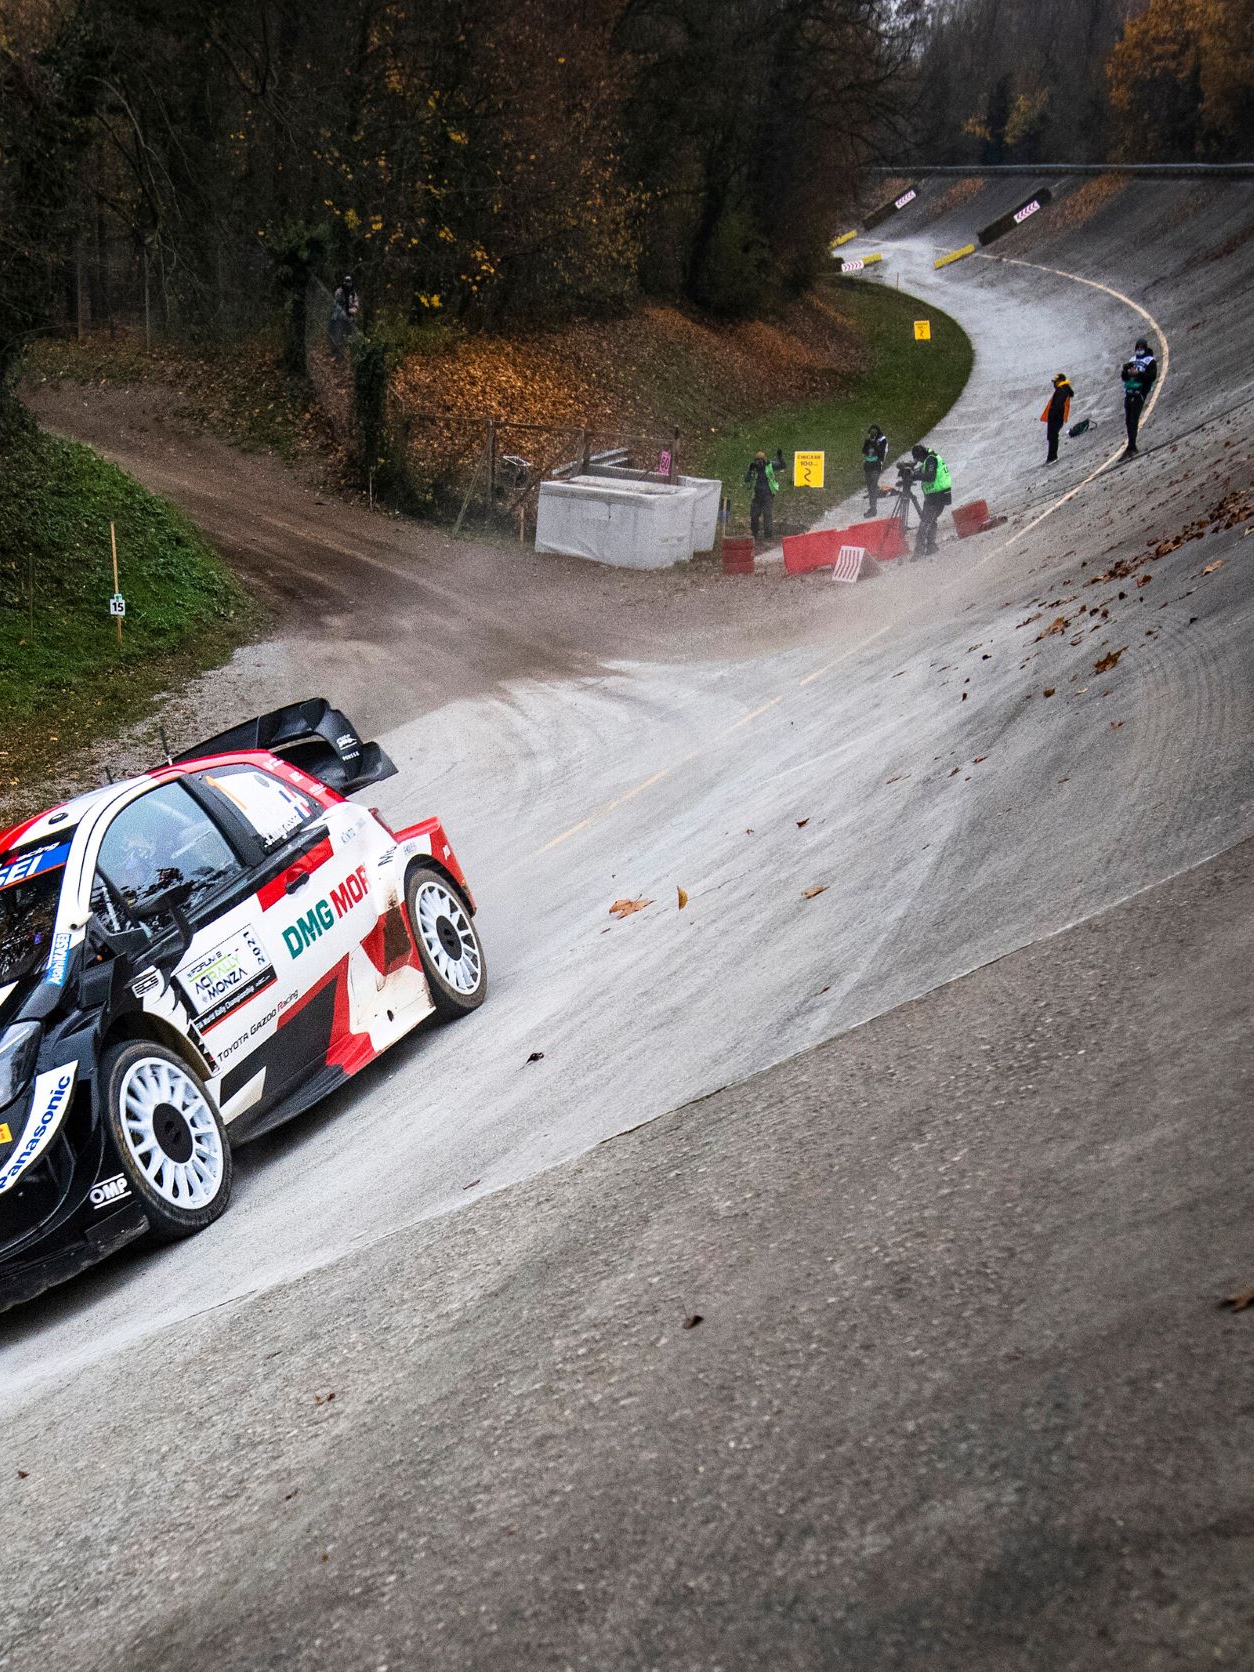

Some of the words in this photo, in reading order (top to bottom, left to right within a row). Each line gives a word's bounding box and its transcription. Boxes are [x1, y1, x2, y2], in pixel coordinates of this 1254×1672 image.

[112, 602, 124, 612] 15
[282, 899, 334, 960] DMG
[243, 931, 266, 966] 2021
[208, 968, 248, 1000] MONZA
[217, 1033, 249, 1062] TOYOTA
[250, 1009, 277, 1036] GAZOO
[277, 989, 299, 1012] Racing
[89, 1177, 128, 1205] OMP
